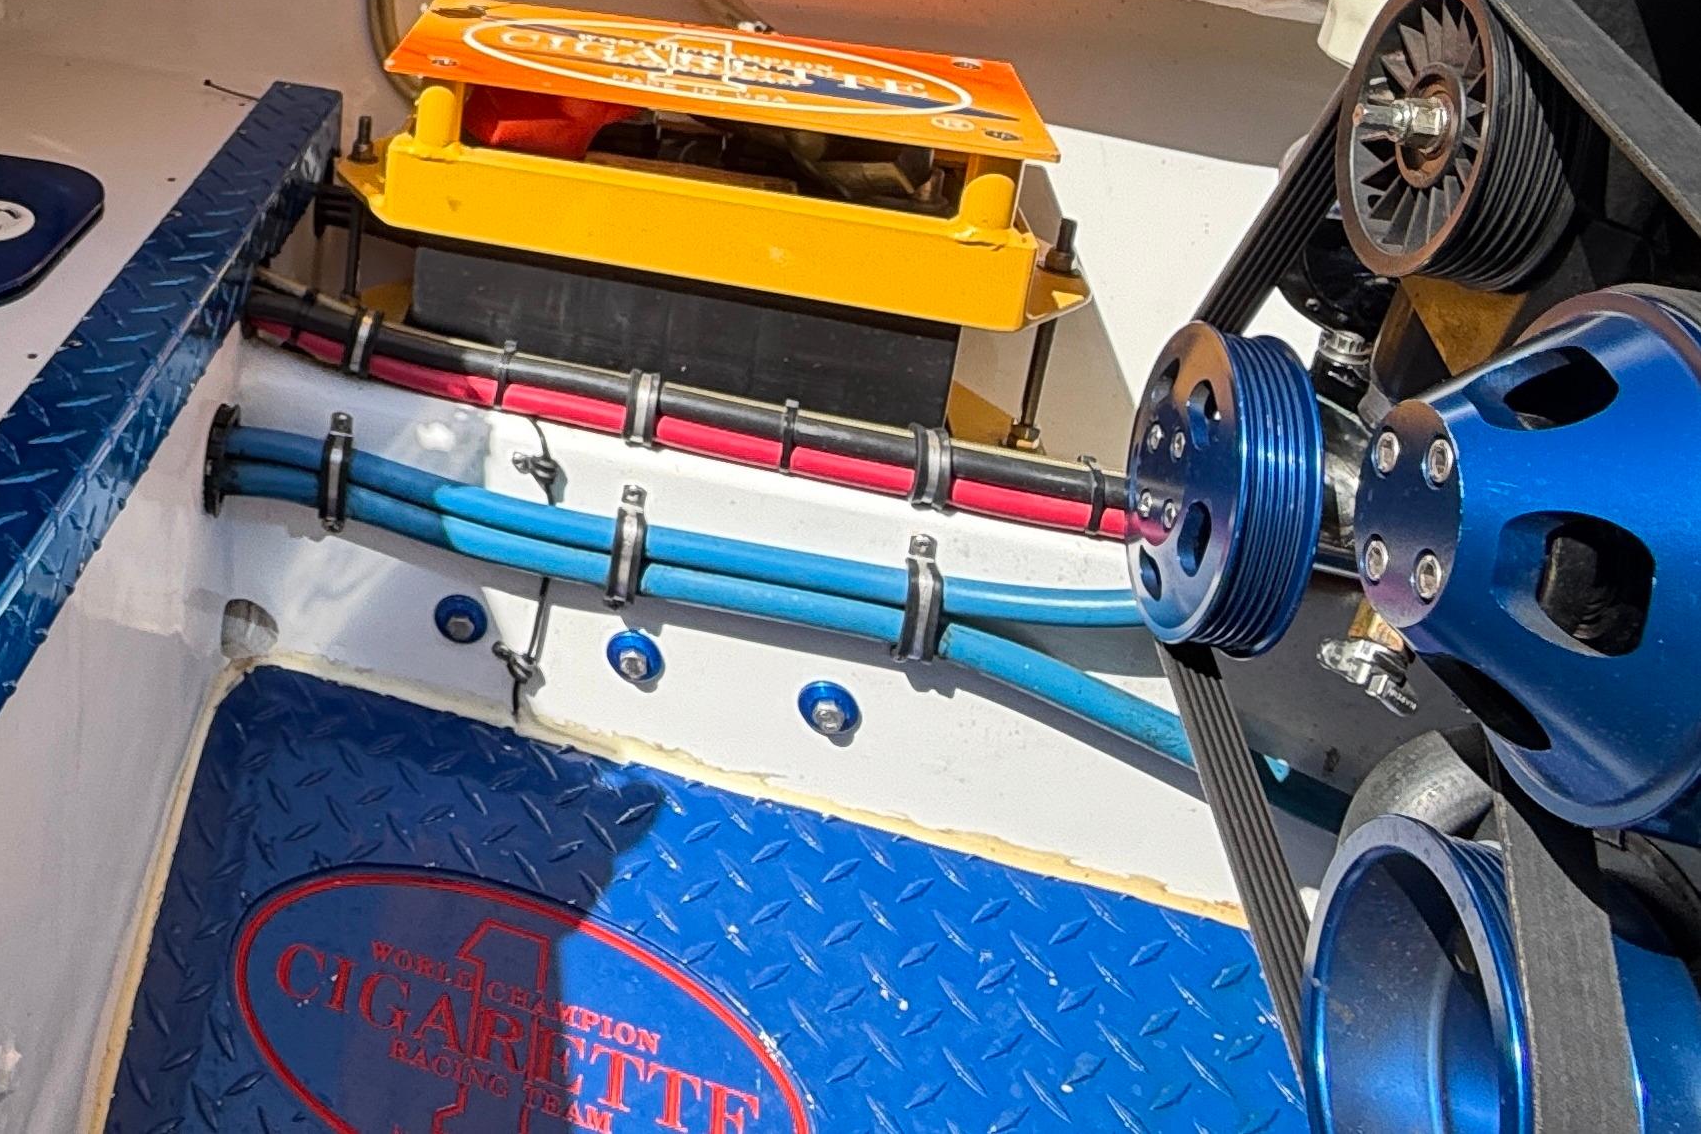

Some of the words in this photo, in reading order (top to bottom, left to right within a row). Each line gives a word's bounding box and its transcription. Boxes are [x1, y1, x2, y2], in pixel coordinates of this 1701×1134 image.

[275, 943, 760, 1134] CIGARETTE
[370, 939, 478, 992] WORLD
[485, 979, 662, 1056] CHAMPION
[388, 1037, 509, 1098] RACING
[523, 1080, 613, 1134] TEAM
